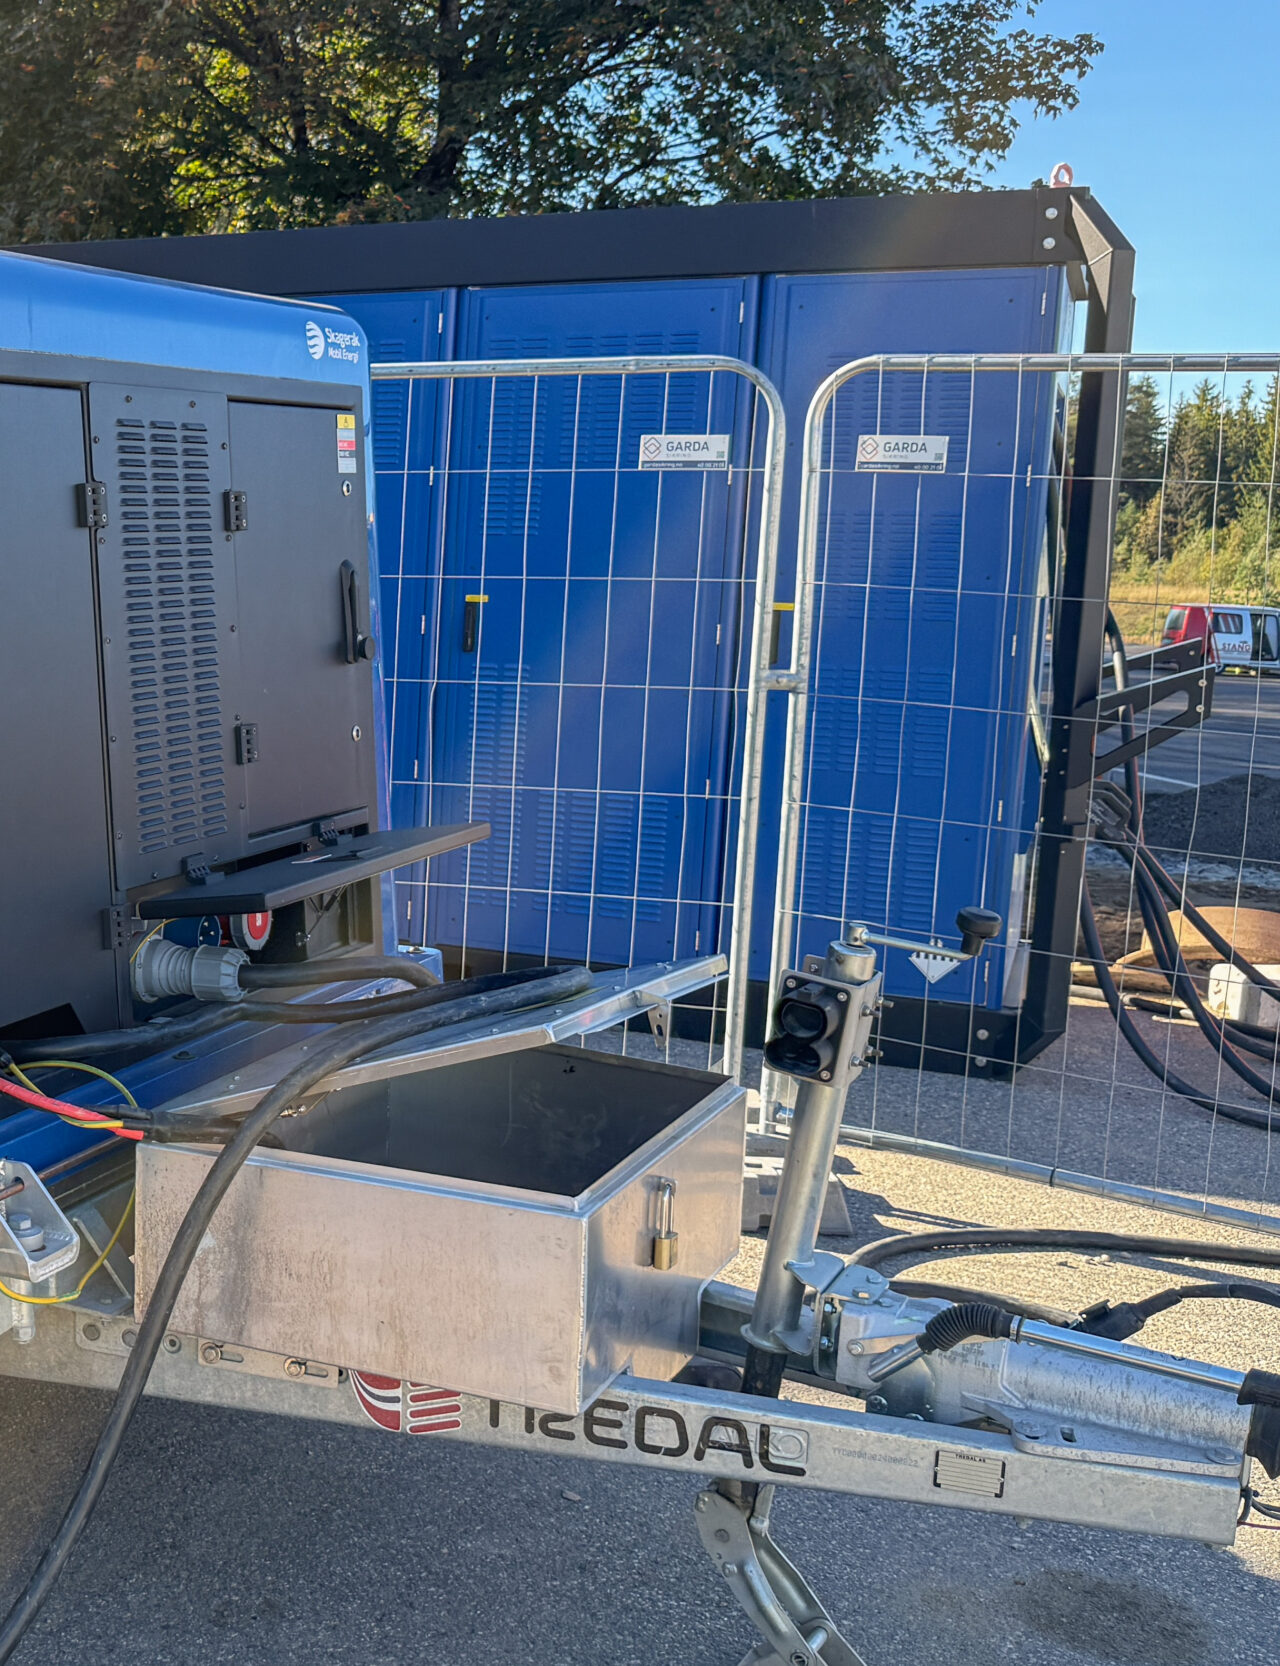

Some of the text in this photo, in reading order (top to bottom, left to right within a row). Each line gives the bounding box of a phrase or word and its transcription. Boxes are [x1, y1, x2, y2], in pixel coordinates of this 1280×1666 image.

[324, 327, 361, 348] Skagerak
[328, 346, 359, 364] Mobil Energi
[666, 441, 710, 452] GARDA
[883, 441, 928, 453] GARDA
